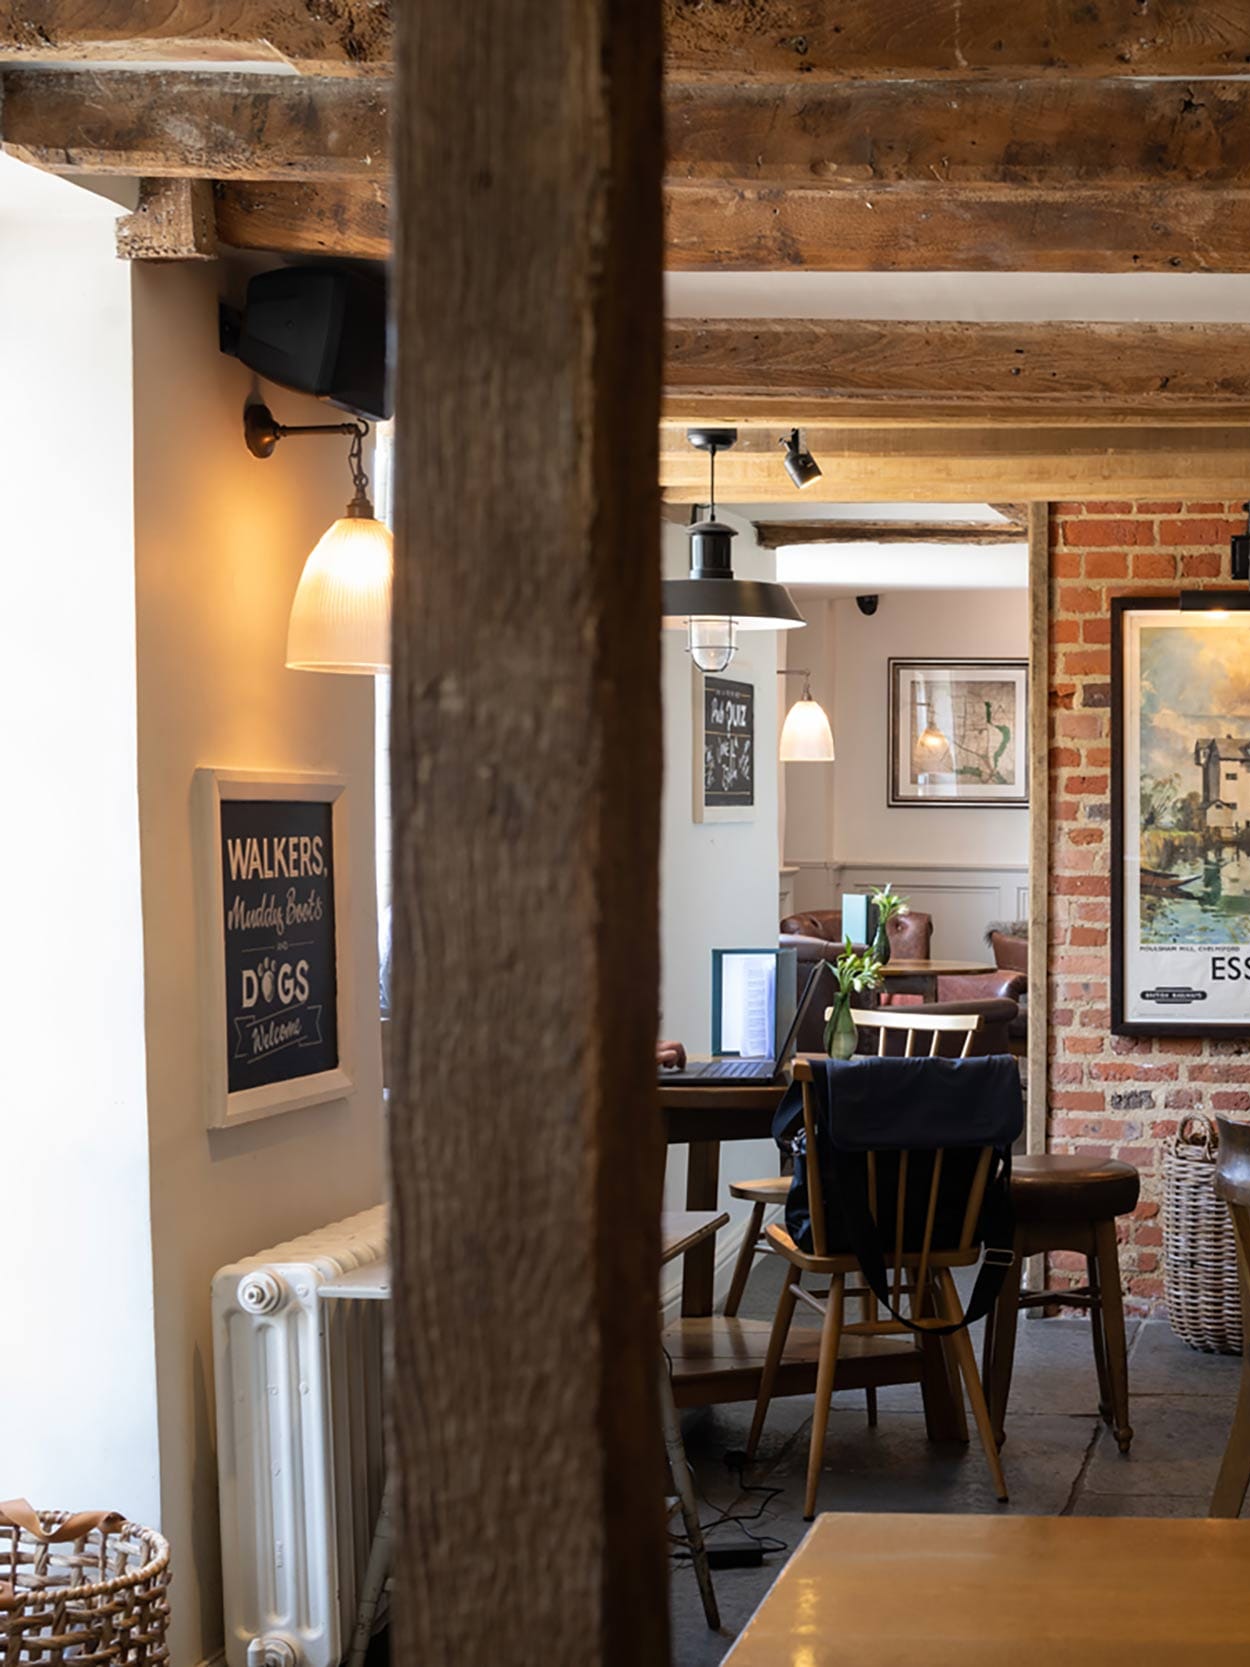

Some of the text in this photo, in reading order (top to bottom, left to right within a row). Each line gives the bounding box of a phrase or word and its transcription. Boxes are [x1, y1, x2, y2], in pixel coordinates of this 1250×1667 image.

[227, 836, 328, 880] WALKERS,
[228, 886, 323, 935] Muddy Boots
[251, 1017, 302, 1054] Welcome
